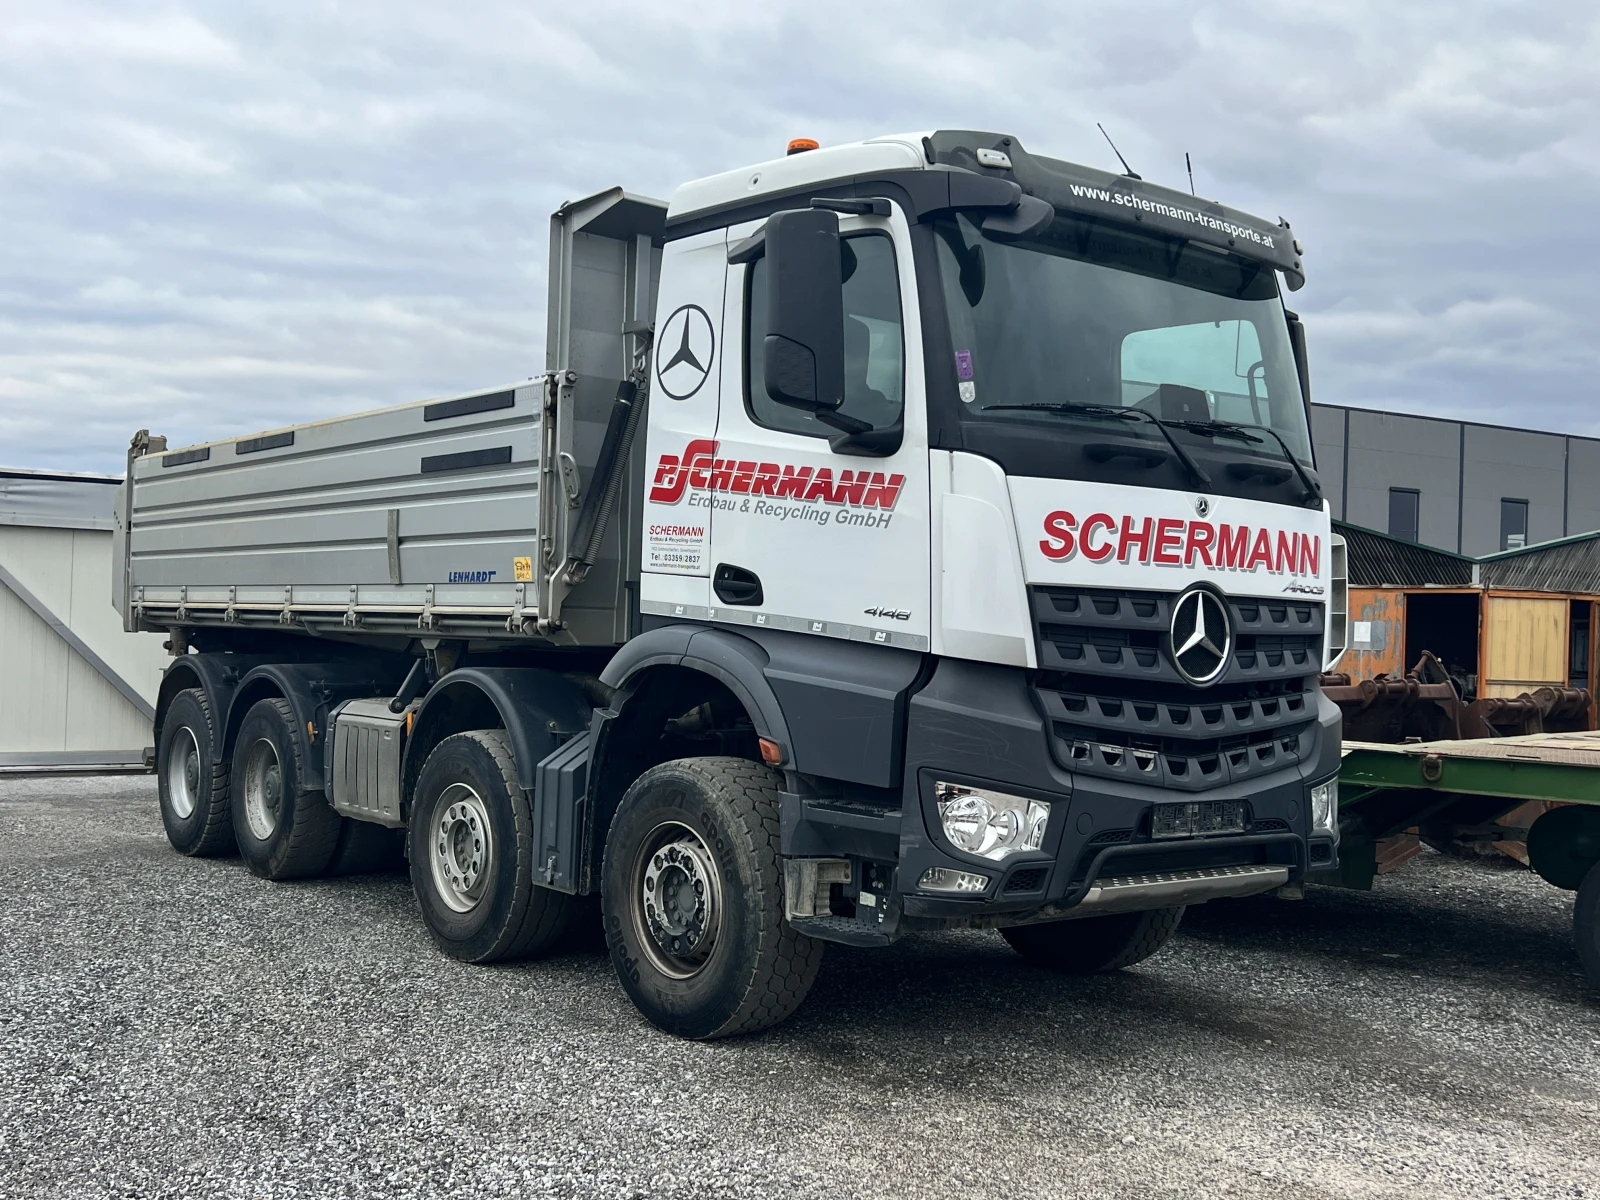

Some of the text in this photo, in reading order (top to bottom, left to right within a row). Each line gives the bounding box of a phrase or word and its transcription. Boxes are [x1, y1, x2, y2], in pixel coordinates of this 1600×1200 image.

[1070, 183, 1275, 249] www.schermann-transporte.at
[688, 492, 892, 529] Erdbau & Recycling GmbH
[649, 525, 704, 536] SCHERMANN
[1039, 510, 1321, 578] SCHERMANN
[448, 570, 497, 583] LENHARDT
[864, 606, 912, 621] 4148
